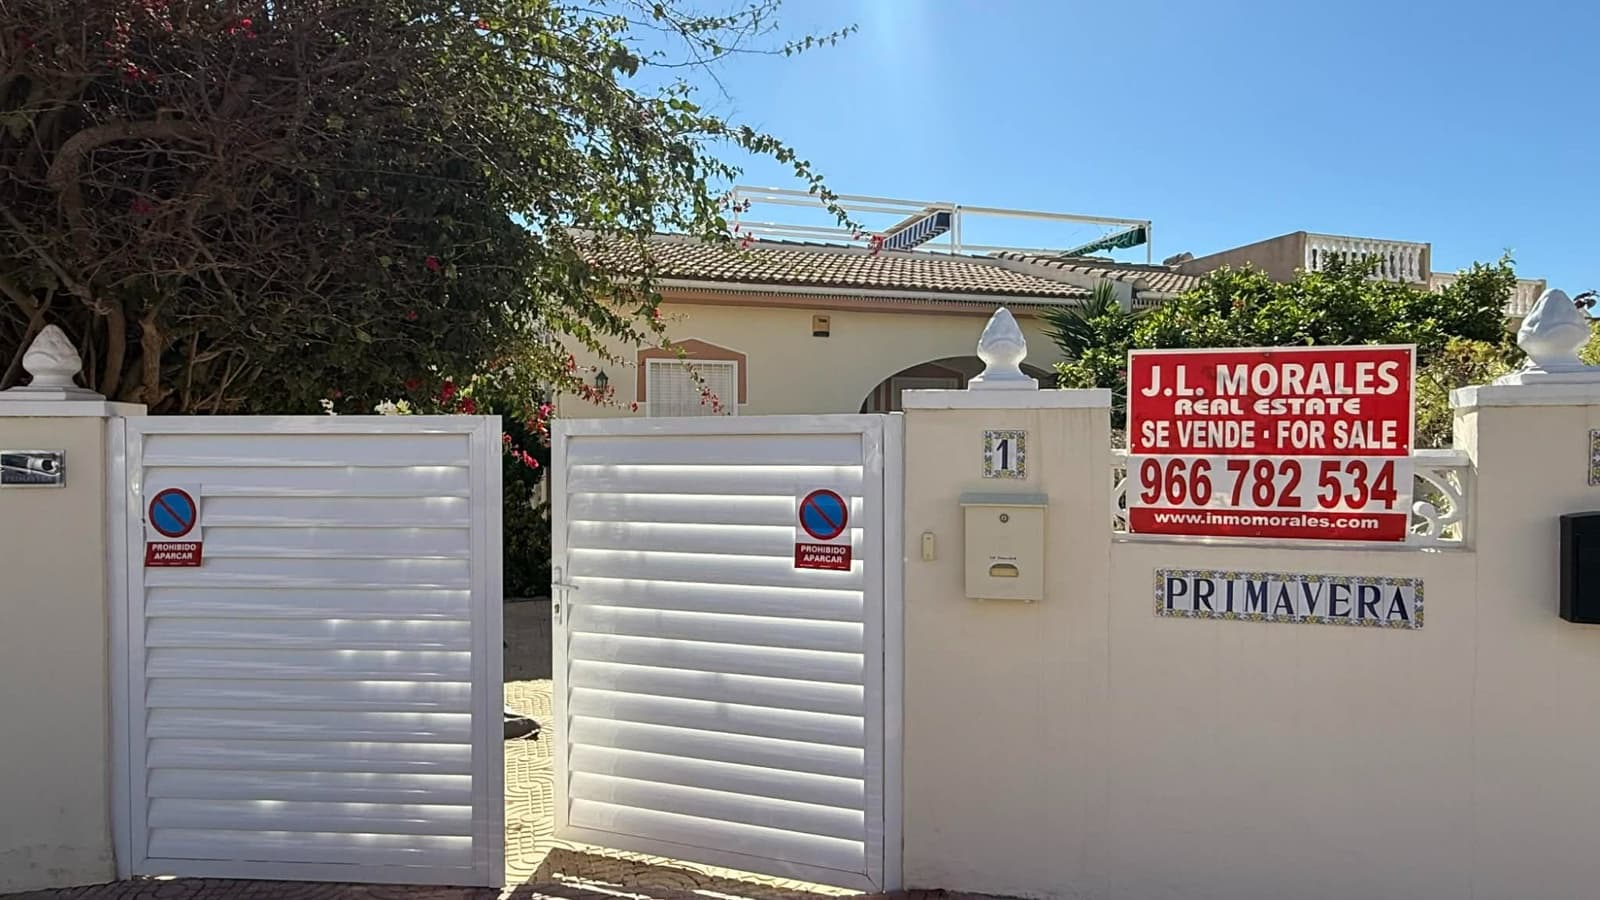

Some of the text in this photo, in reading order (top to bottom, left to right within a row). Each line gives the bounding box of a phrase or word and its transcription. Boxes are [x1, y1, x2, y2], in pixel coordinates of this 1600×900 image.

[1141, 361, 1399, 397] J.L. MORALES
[1174, 398, 1361, 415] REAL ESTATE
[1141, 420, 1169, 448] SE
[1176, 420, 1255, 448] VENDE
[1277, 420, 1327, 448] FOR
[1333, 420, 1397, 449] SALE
[996, 439, 1008, 470] 1
[1140, 458, 1397, 510] 966 782 534
[1154, 512, 1379, 529] www.inmomorales.com
[151, 543, 197, 552] PROHIBIDO
[153, 552, 193, 560] APARCAR
[800, 544, 847, 555] PROHIBIDO
[803, 554, 842, 563] APARCAR
[1166, 577, 1409, 620] PRIMAVERA
